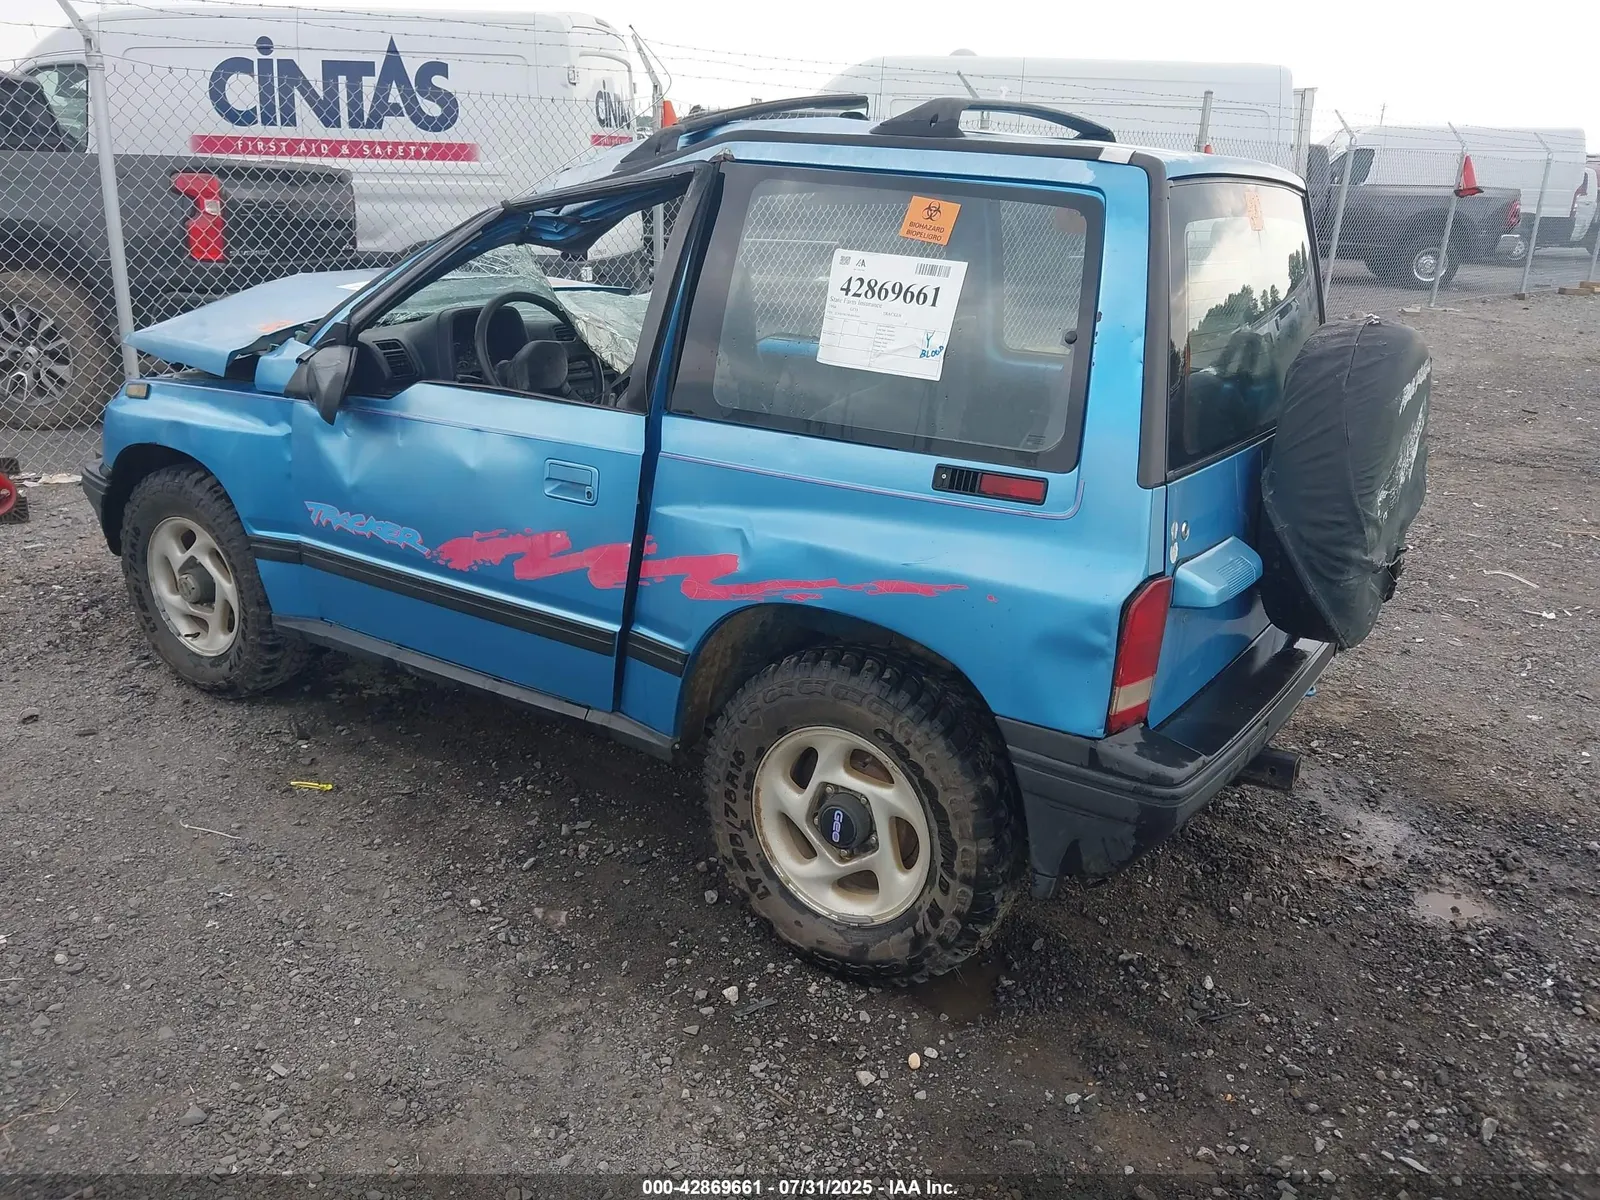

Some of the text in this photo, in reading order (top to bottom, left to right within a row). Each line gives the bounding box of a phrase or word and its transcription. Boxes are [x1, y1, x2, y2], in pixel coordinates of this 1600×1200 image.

[238, 140, 429, 156] FIRST AID & SAFETY
[909, 221, 945, 233] BIOHAZARD
[906, 229, 942, 241] BIOPELIGRO
[840, 275, 941, 308] 42869661
[857, 299, 883, 308] Insurance
